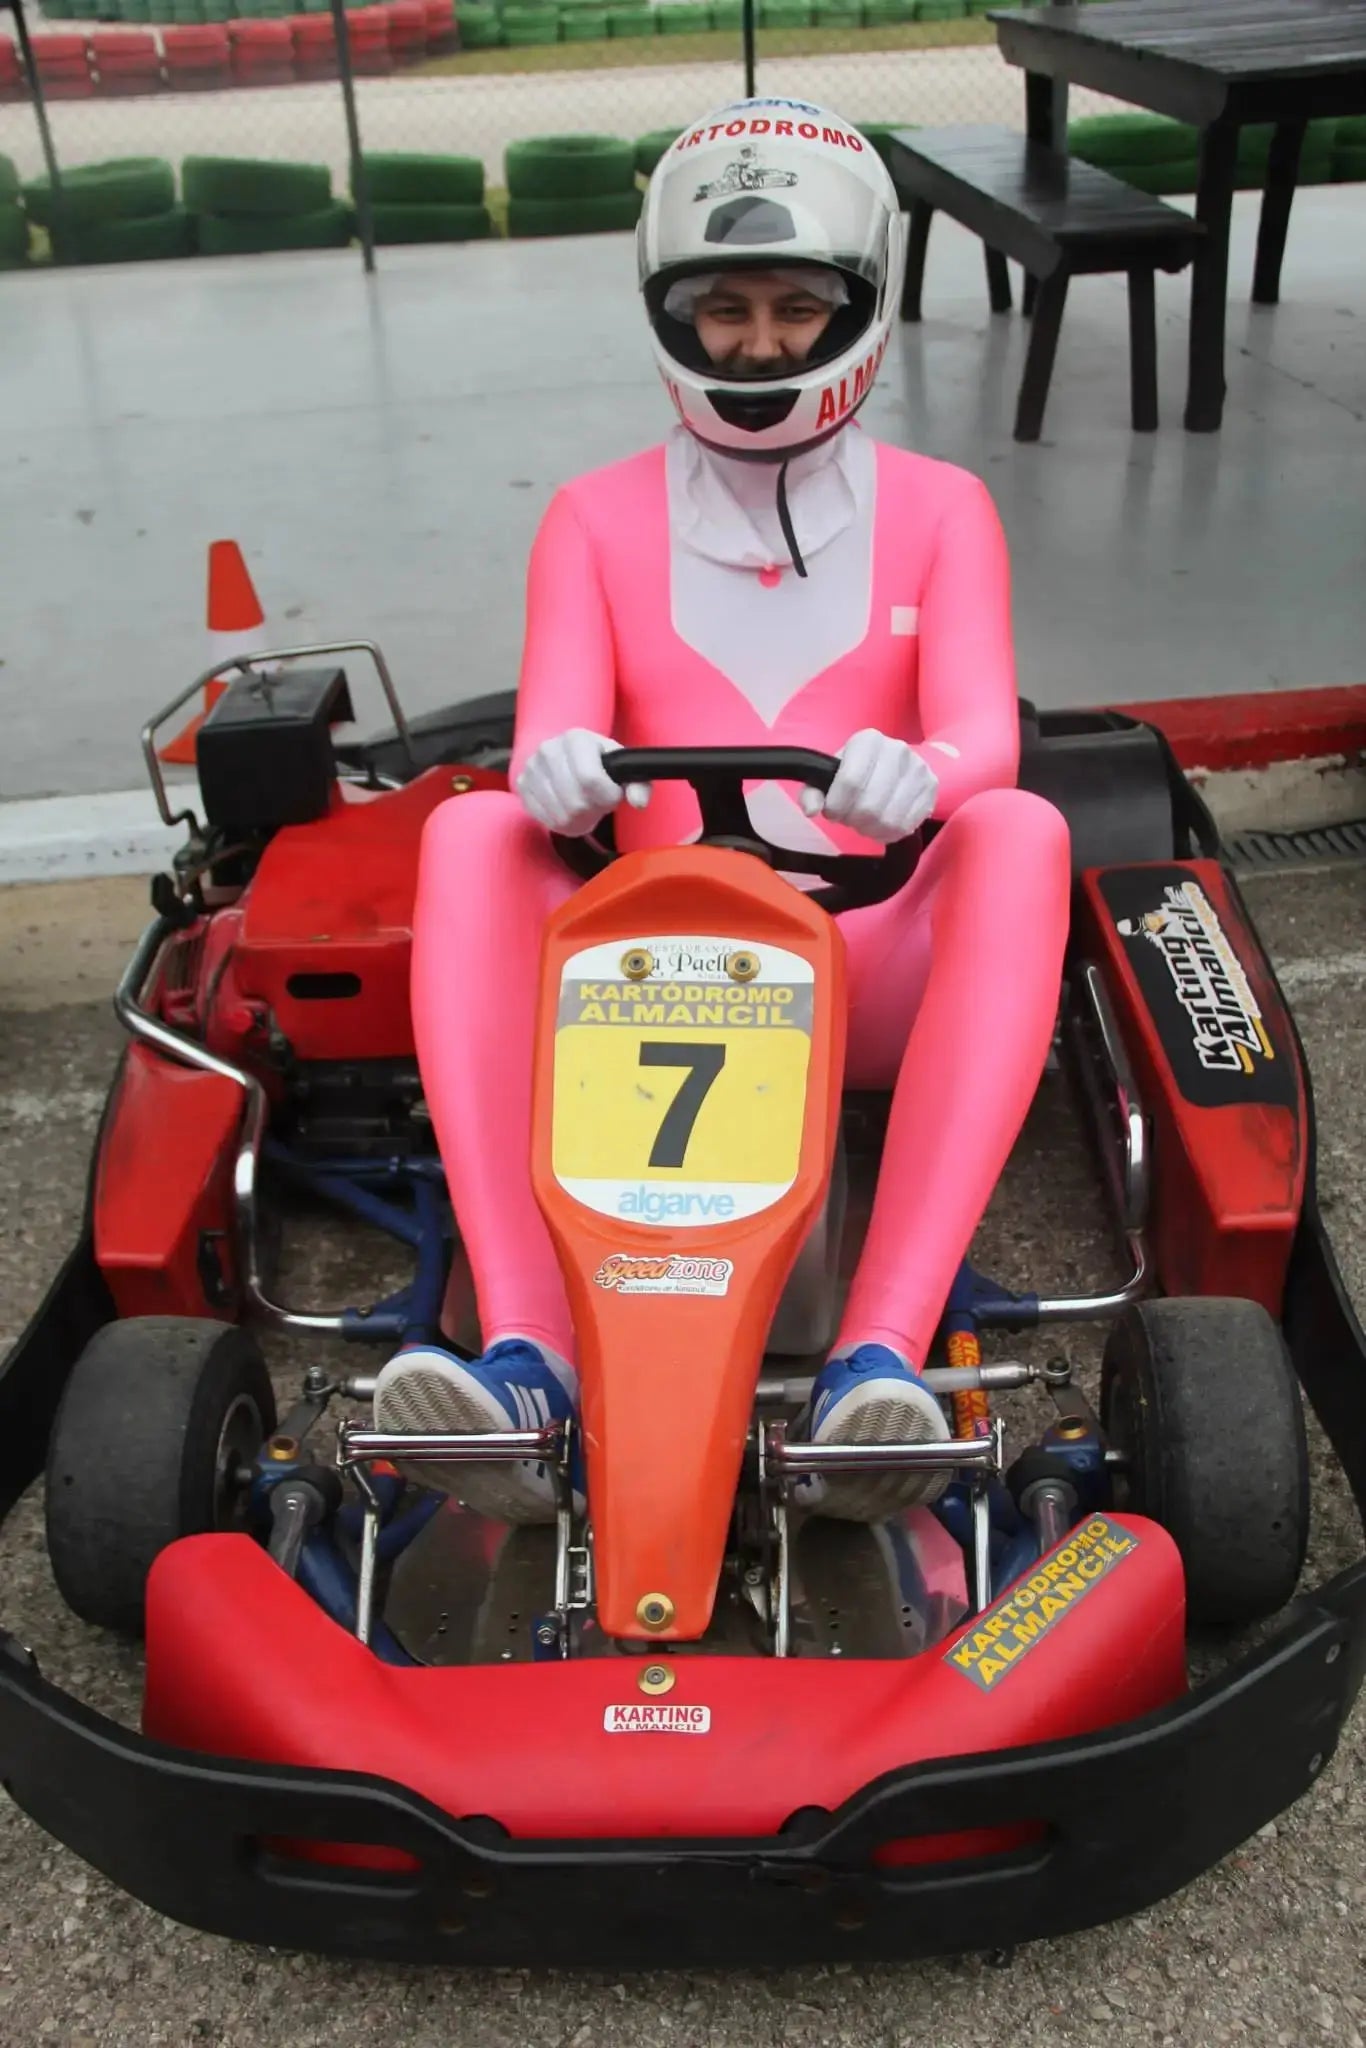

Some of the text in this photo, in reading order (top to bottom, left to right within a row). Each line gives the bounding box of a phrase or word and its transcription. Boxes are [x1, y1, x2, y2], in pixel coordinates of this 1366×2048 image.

[668, 952, 728, 973] Paell
[1167, 905, 1258, 1047] Almancil
[580, 981, 794, 1005] KARTÓDROMO
[1160, 935, 1236, 1066] Karting
[579, 1002, 794, 1025] ALMANCIL
[639, 1041, 726, 1168] 7
[618, 1184, 735, 1222] algarve
[977, 1537, 1130, 1686] ALMANCIL
[613, 1706, 704, 1723] KARTING
[613, 1723, 702, 1731] ALMANCIL
